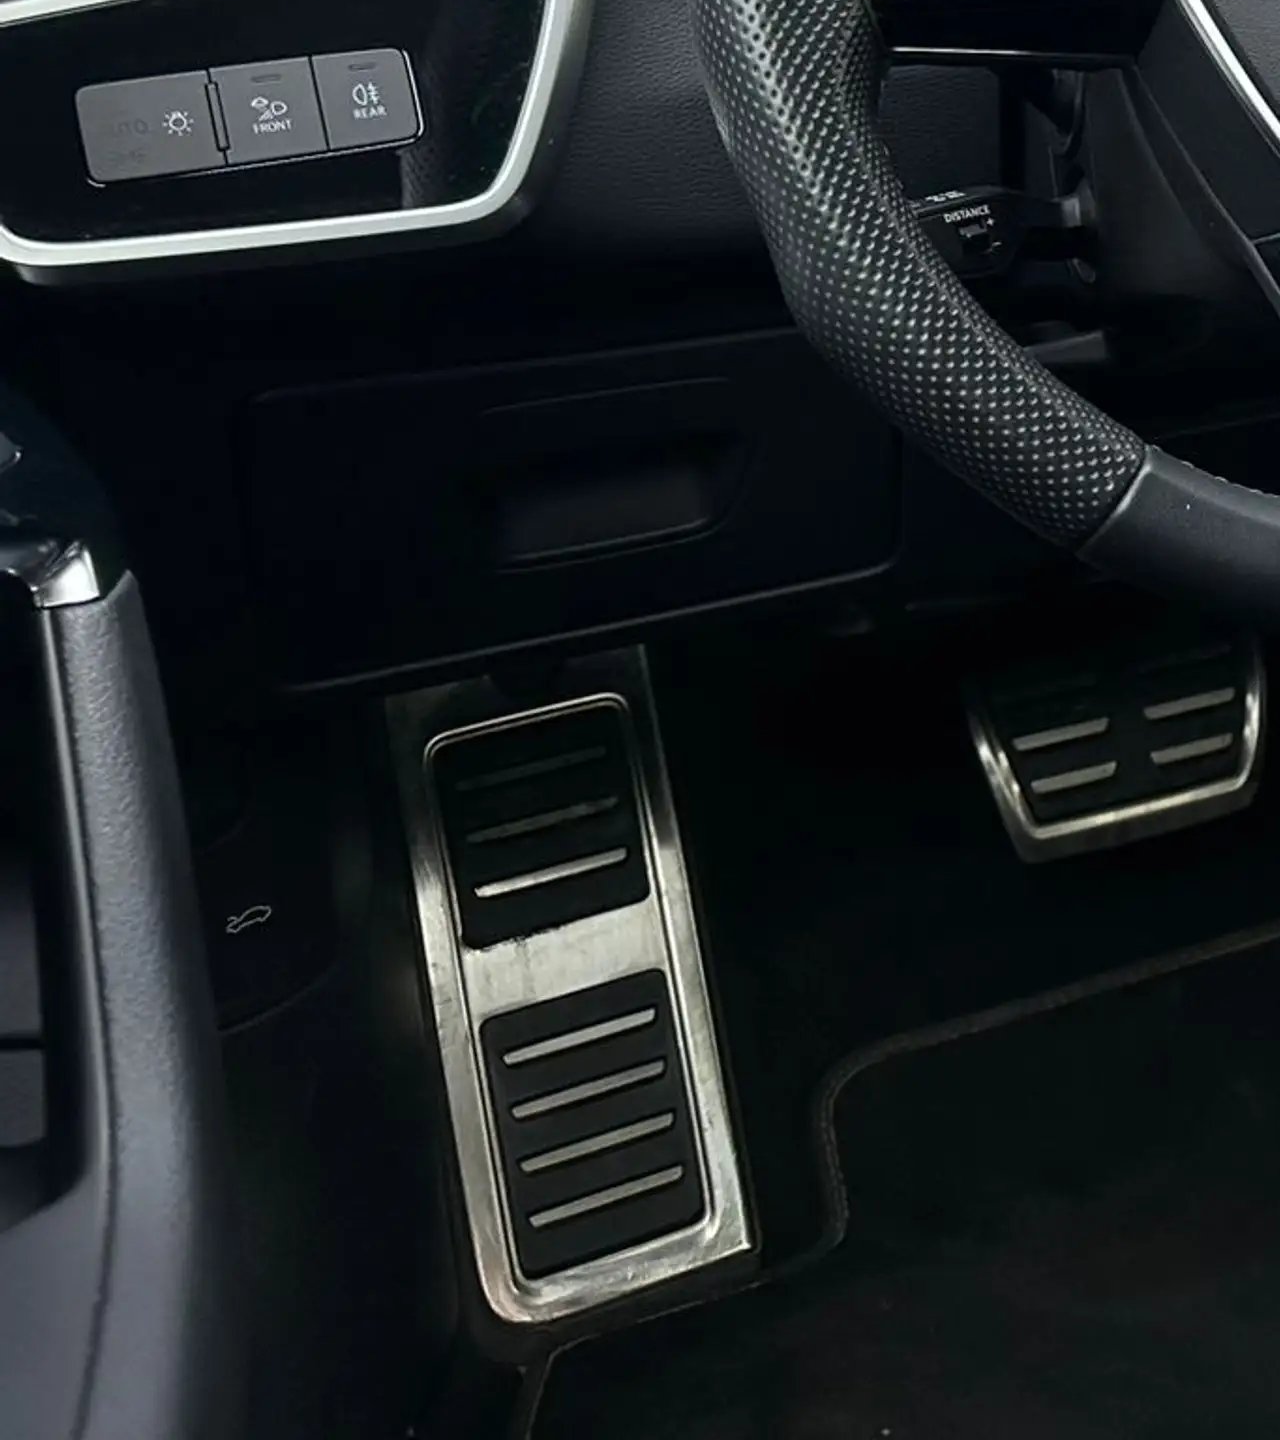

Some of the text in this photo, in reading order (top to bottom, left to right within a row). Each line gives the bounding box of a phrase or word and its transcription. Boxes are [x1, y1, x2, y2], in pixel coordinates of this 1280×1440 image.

[353, 105, 389, 120] REAR
[253, 120, 293, 135] FRONT
[944, 205, 990, 223] DISTANCE
